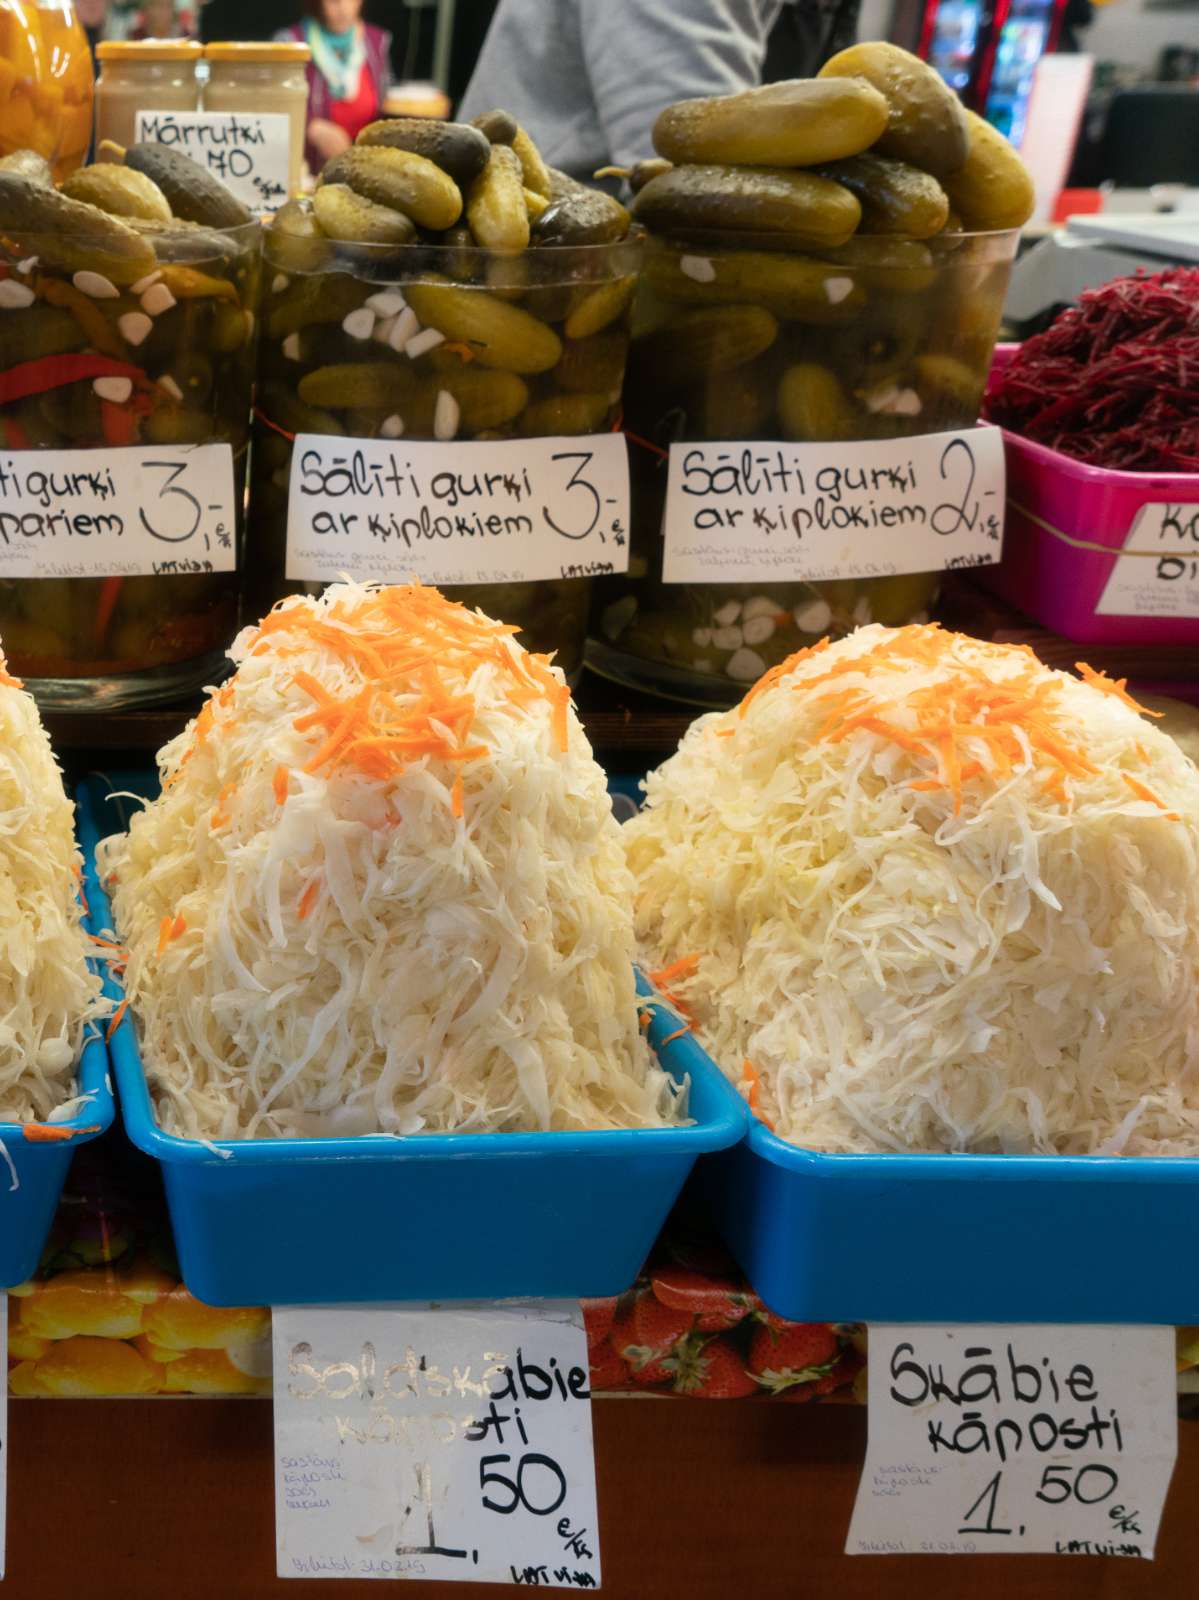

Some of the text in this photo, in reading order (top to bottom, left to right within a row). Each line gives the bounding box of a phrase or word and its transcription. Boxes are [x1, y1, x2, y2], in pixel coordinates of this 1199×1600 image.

[300, 450, 531, 506] Sālīti gurķi
[681, 449, 916, 501] Sālīti gurķi
[311, 511, 358, 535] ar
[694, 507, 744, 530] ar
[890, 1342, 1098, 1405] Skābie
[928, 1406, 1122, 1462] kāposti
